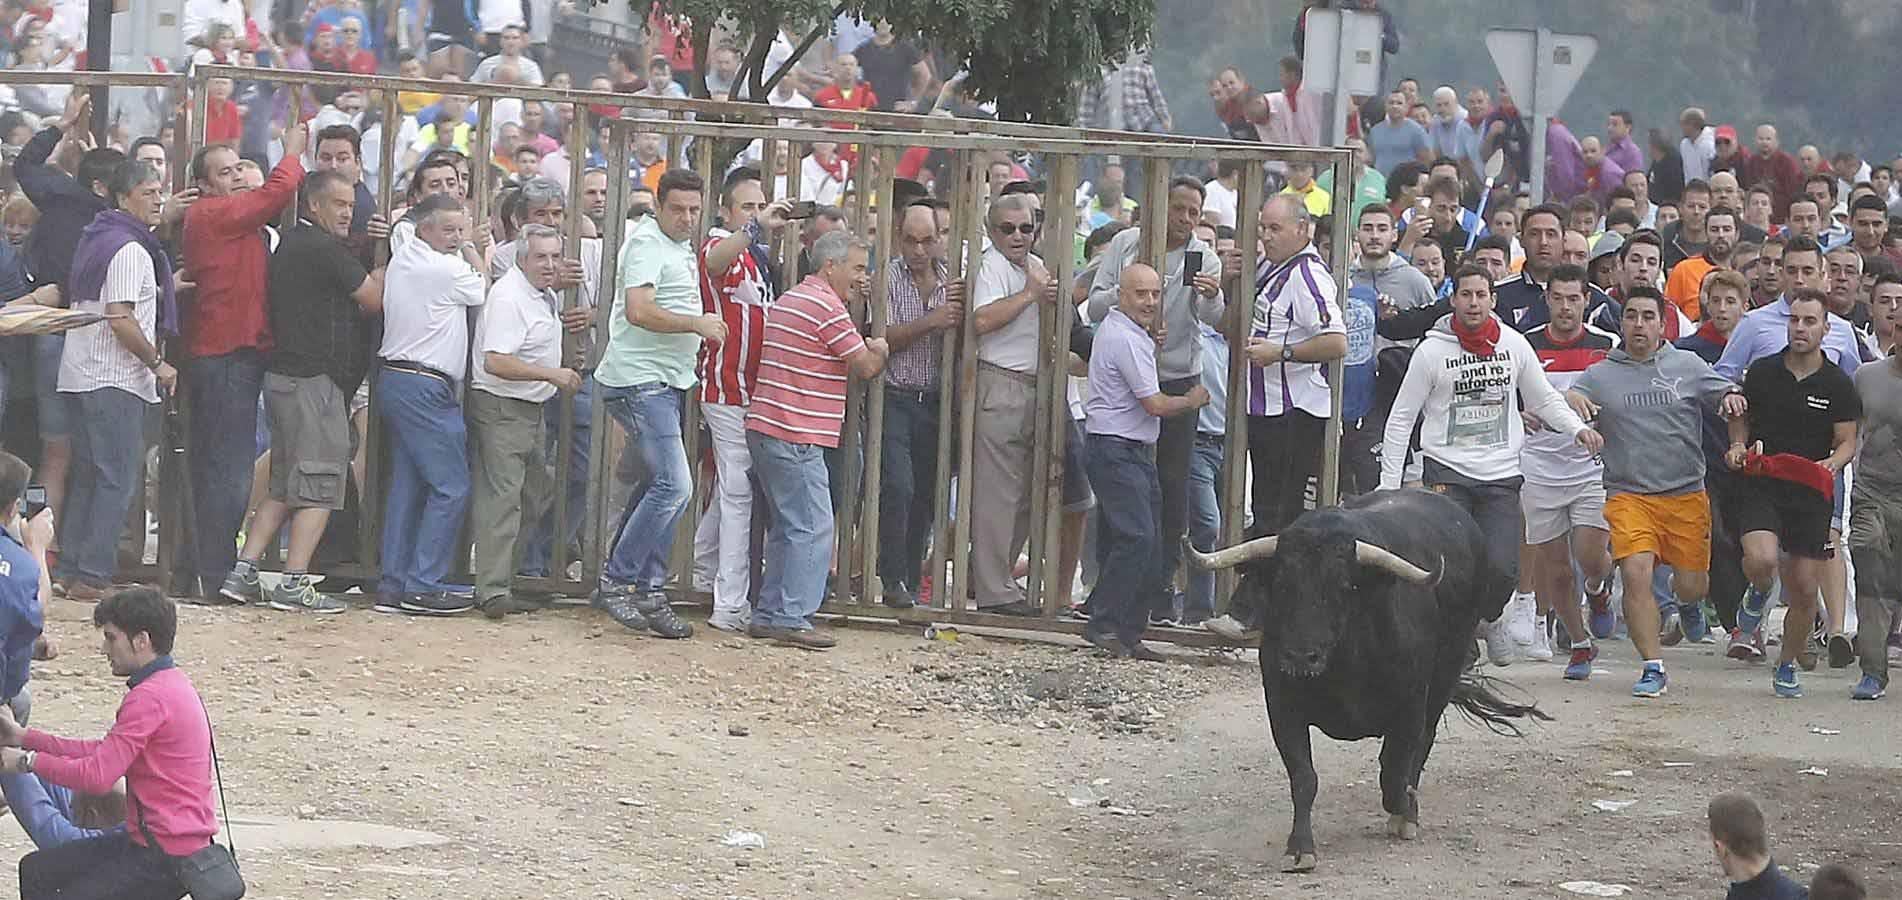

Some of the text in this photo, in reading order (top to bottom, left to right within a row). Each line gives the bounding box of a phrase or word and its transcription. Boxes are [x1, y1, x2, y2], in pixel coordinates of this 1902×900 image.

[1461, 364, 1487, 379] and
[1454, 375, 1511, 391] inforced
[0, 553, 11, 577] a
